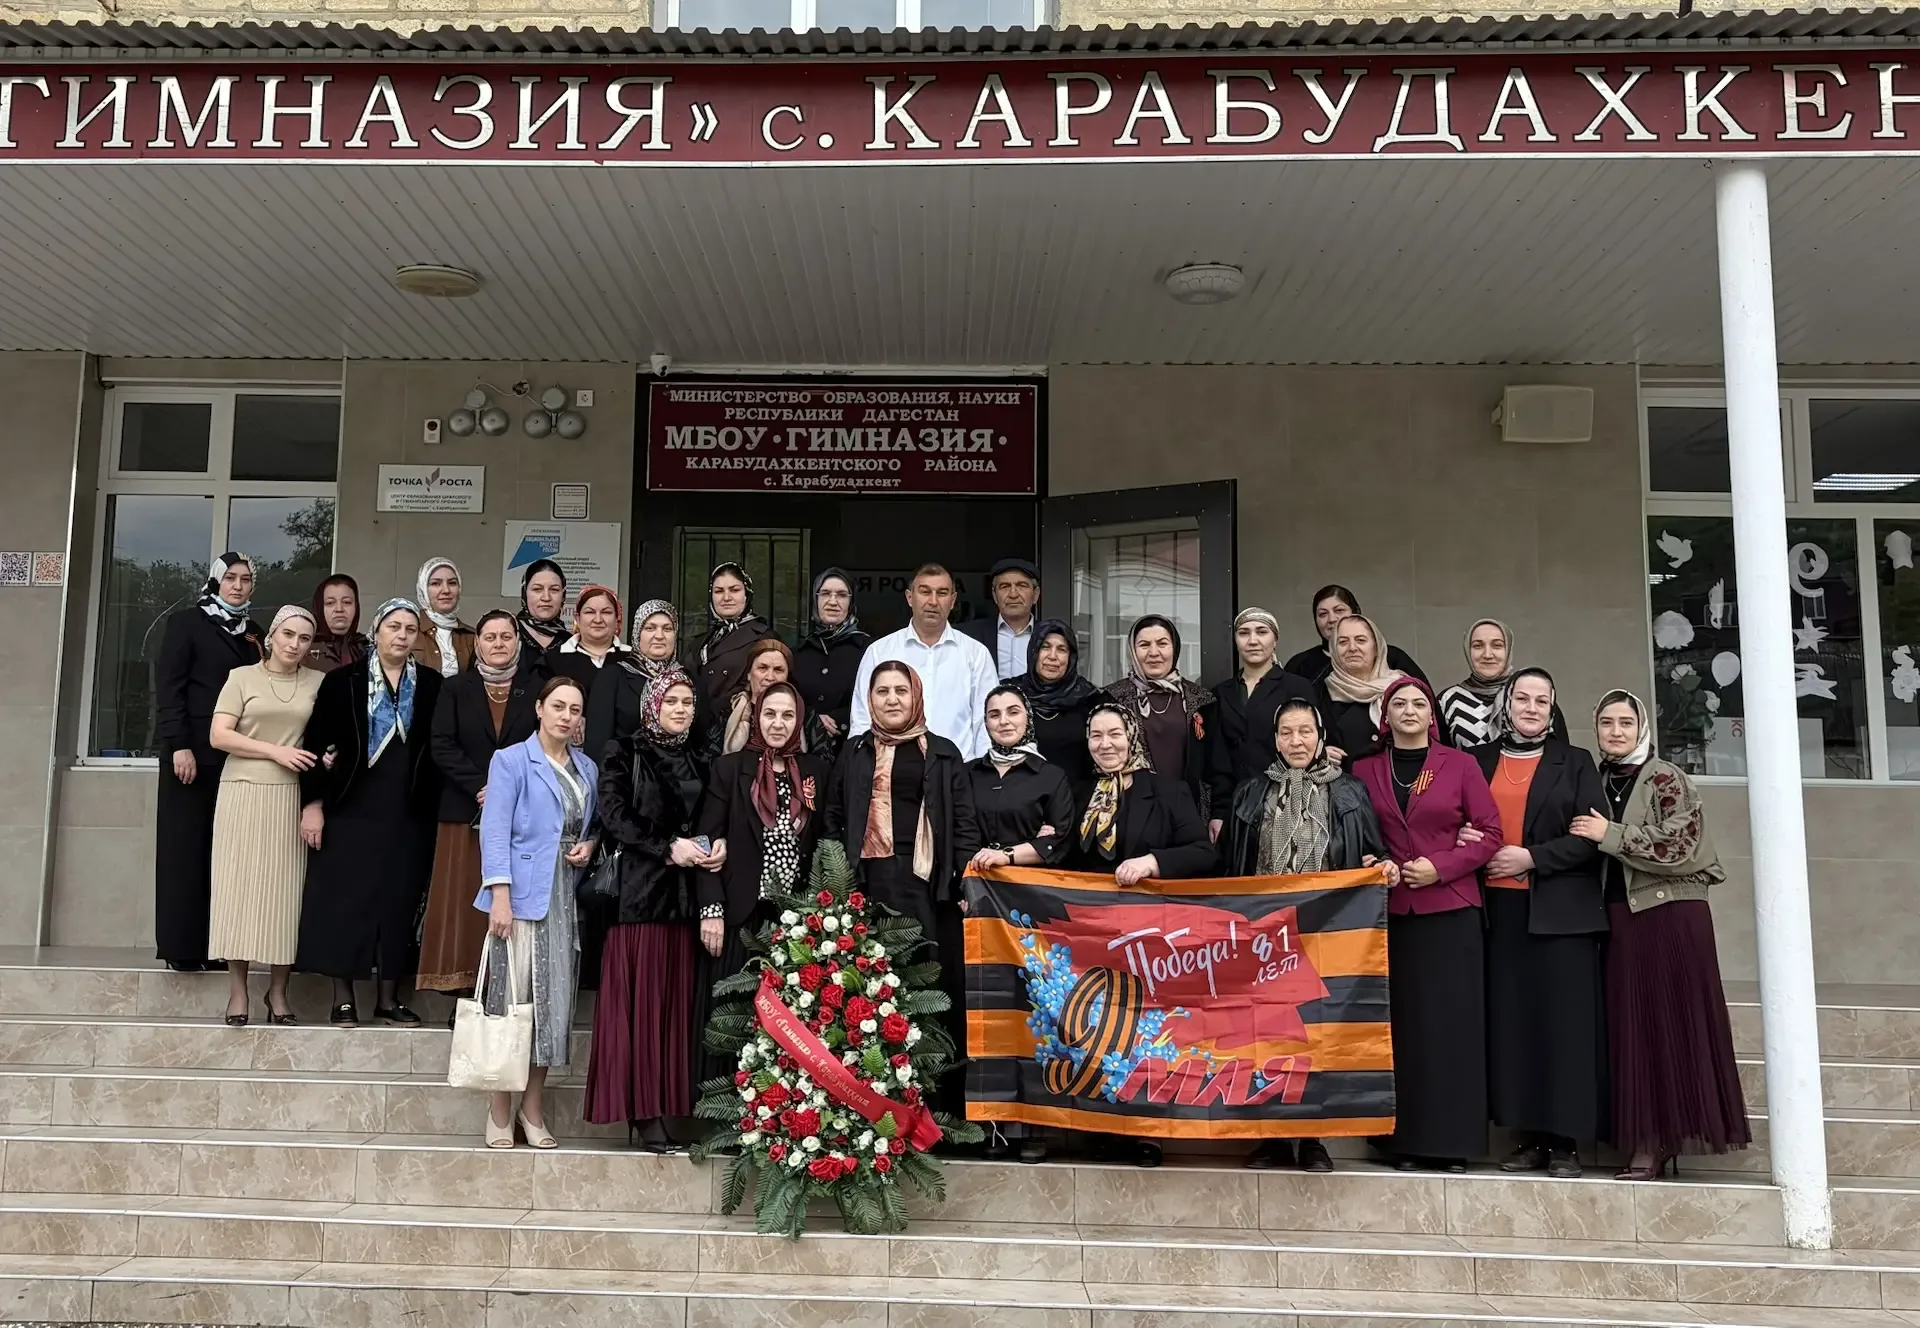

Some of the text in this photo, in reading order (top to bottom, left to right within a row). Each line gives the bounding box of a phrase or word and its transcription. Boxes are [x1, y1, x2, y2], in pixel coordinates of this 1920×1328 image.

[761, 105, 834, 151] с.
[864, 63, 1920, 154] КАРАБУДАХКЕН
[669, 389, 1021, 406] МИНИСТЕРСТВО ОБРАЗОВАНИЯ, НАУКИ
[724, 407, 960, 423] РЕСПУБЛИКИ ДАГЕСТАН
[664, 425, 768, 451] МБОУ
[685, 454, 998, 472] КАРАБУДАХКЕНТСКОГО РАЙОНА
[388, 477, 473, 487] ТОЧКА РОСТА
[763, 473, 902, 489] с. Карабудахкент
[1107, 919, 1239, 1002] Победа!
[1113, 1054, 1313, 1107] МАЯ
